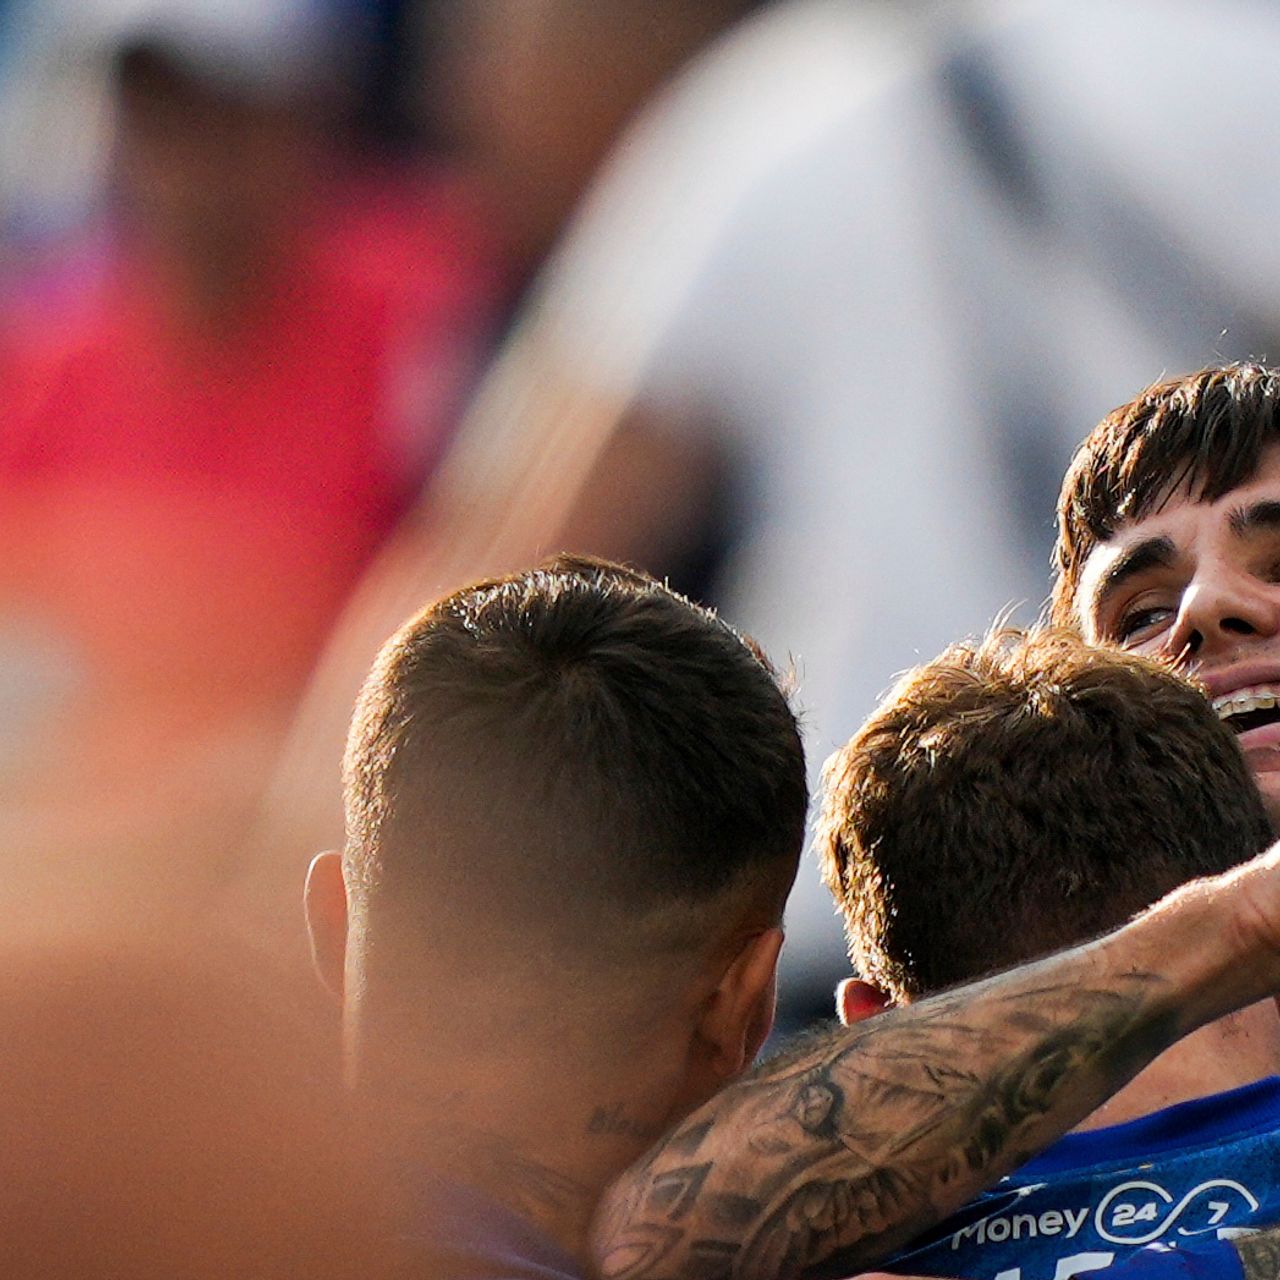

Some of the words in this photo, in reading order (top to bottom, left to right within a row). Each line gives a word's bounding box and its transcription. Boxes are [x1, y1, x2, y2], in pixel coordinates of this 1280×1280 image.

[952, 1208, 1089, 1250] Money
[1112, 1202, 1158, 1227] 24
[1208, 1201, 1230, 1225] 7
